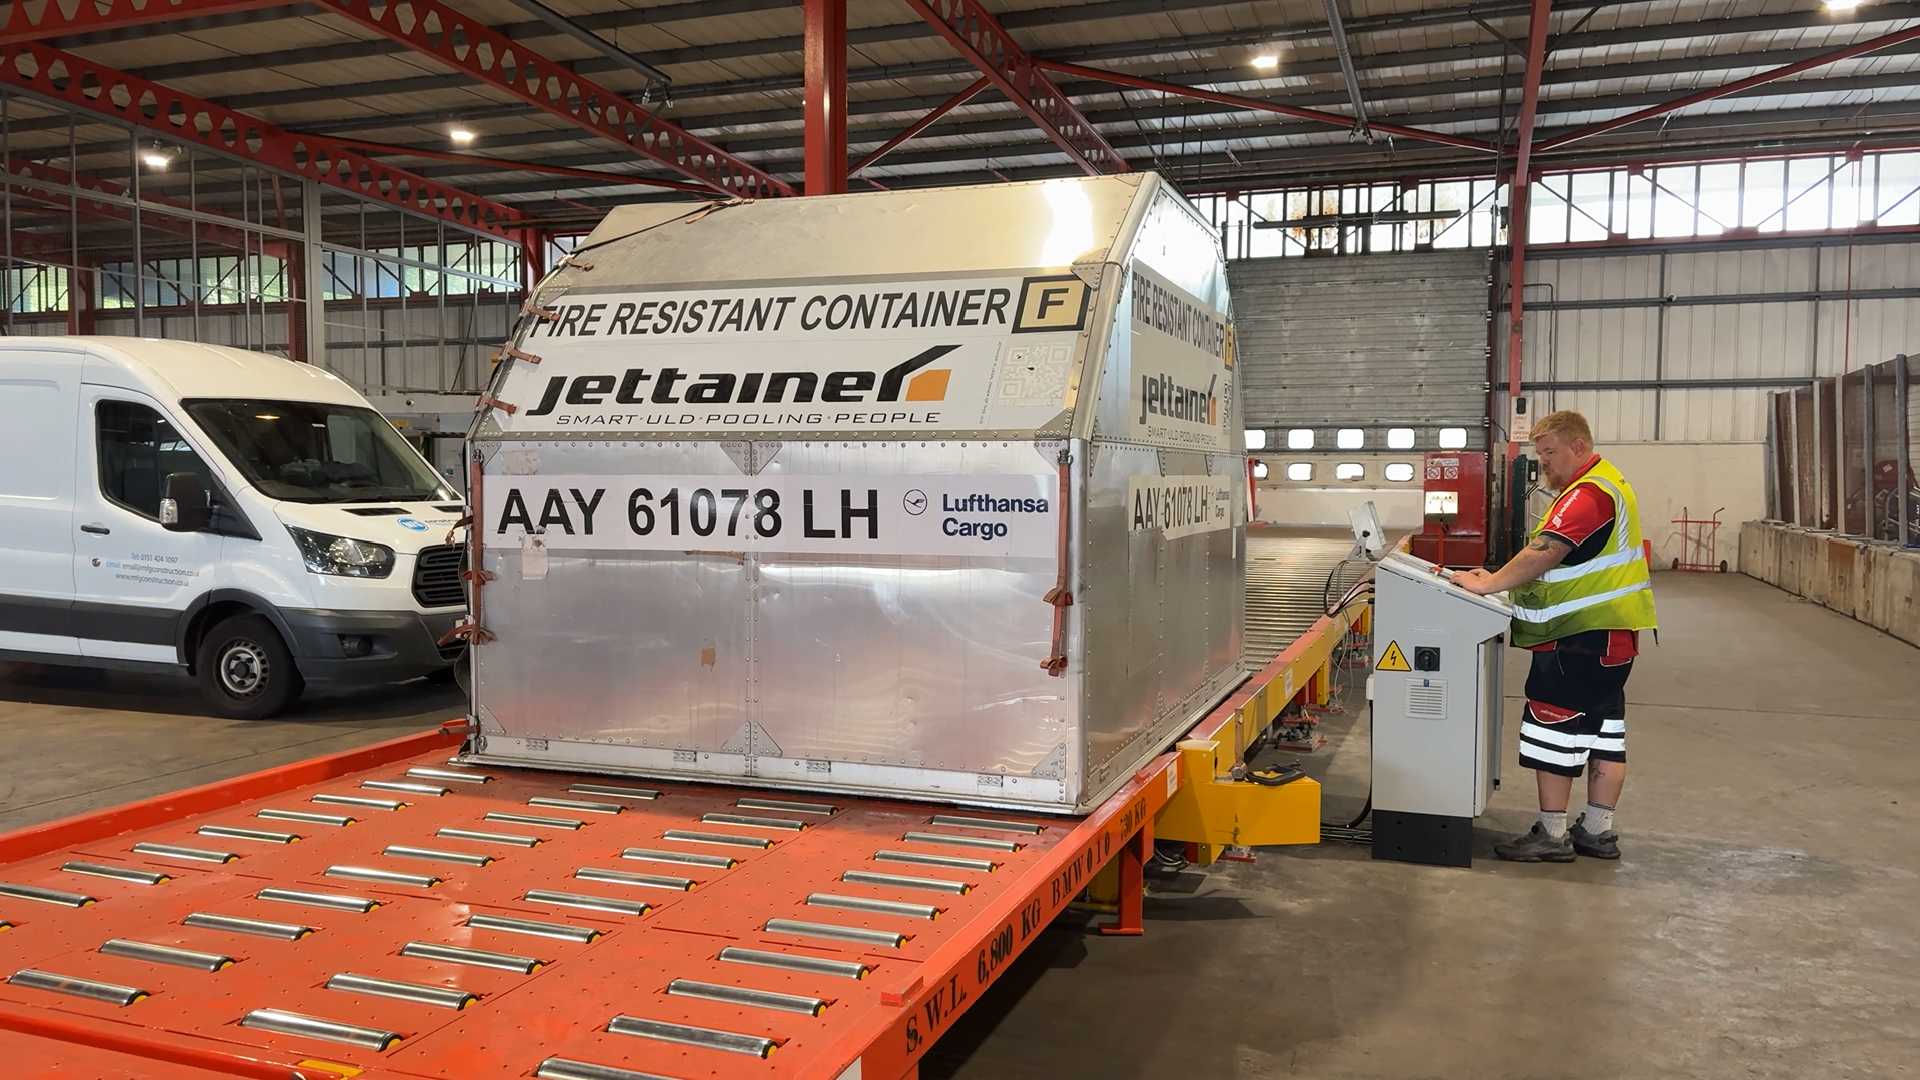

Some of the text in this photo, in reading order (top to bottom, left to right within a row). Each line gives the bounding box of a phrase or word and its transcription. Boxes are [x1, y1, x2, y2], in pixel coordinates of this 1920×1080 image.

[529, 287, 1012, 338] FIRE RESISTANT CONTAINER
[1036, 287, 1070, 320] F
[1131, 271, 1225, 360] FIRE RESISTANT CONTAINER
[525, 343, 964, 417] jettainer
[1138, 372, 1218, 426] jettainer
[496, 487, 879, 540] AAY 61078 LH
[942, 493, 1049, 514] Lufthansa
[1133, 485, 1208, 530] AAY 61078 LH
[1557, 488, 1581, 517] swissport
[941, 517, 1008, 541] Cargo
[140, 553, 153, 561] 0151
[165, 556, 179, 564] 1097
[977, 923, 1014, 988] 6,800
[1020, 898, 1042, 942] KG
[1134, 796, 1147, 827] KG
